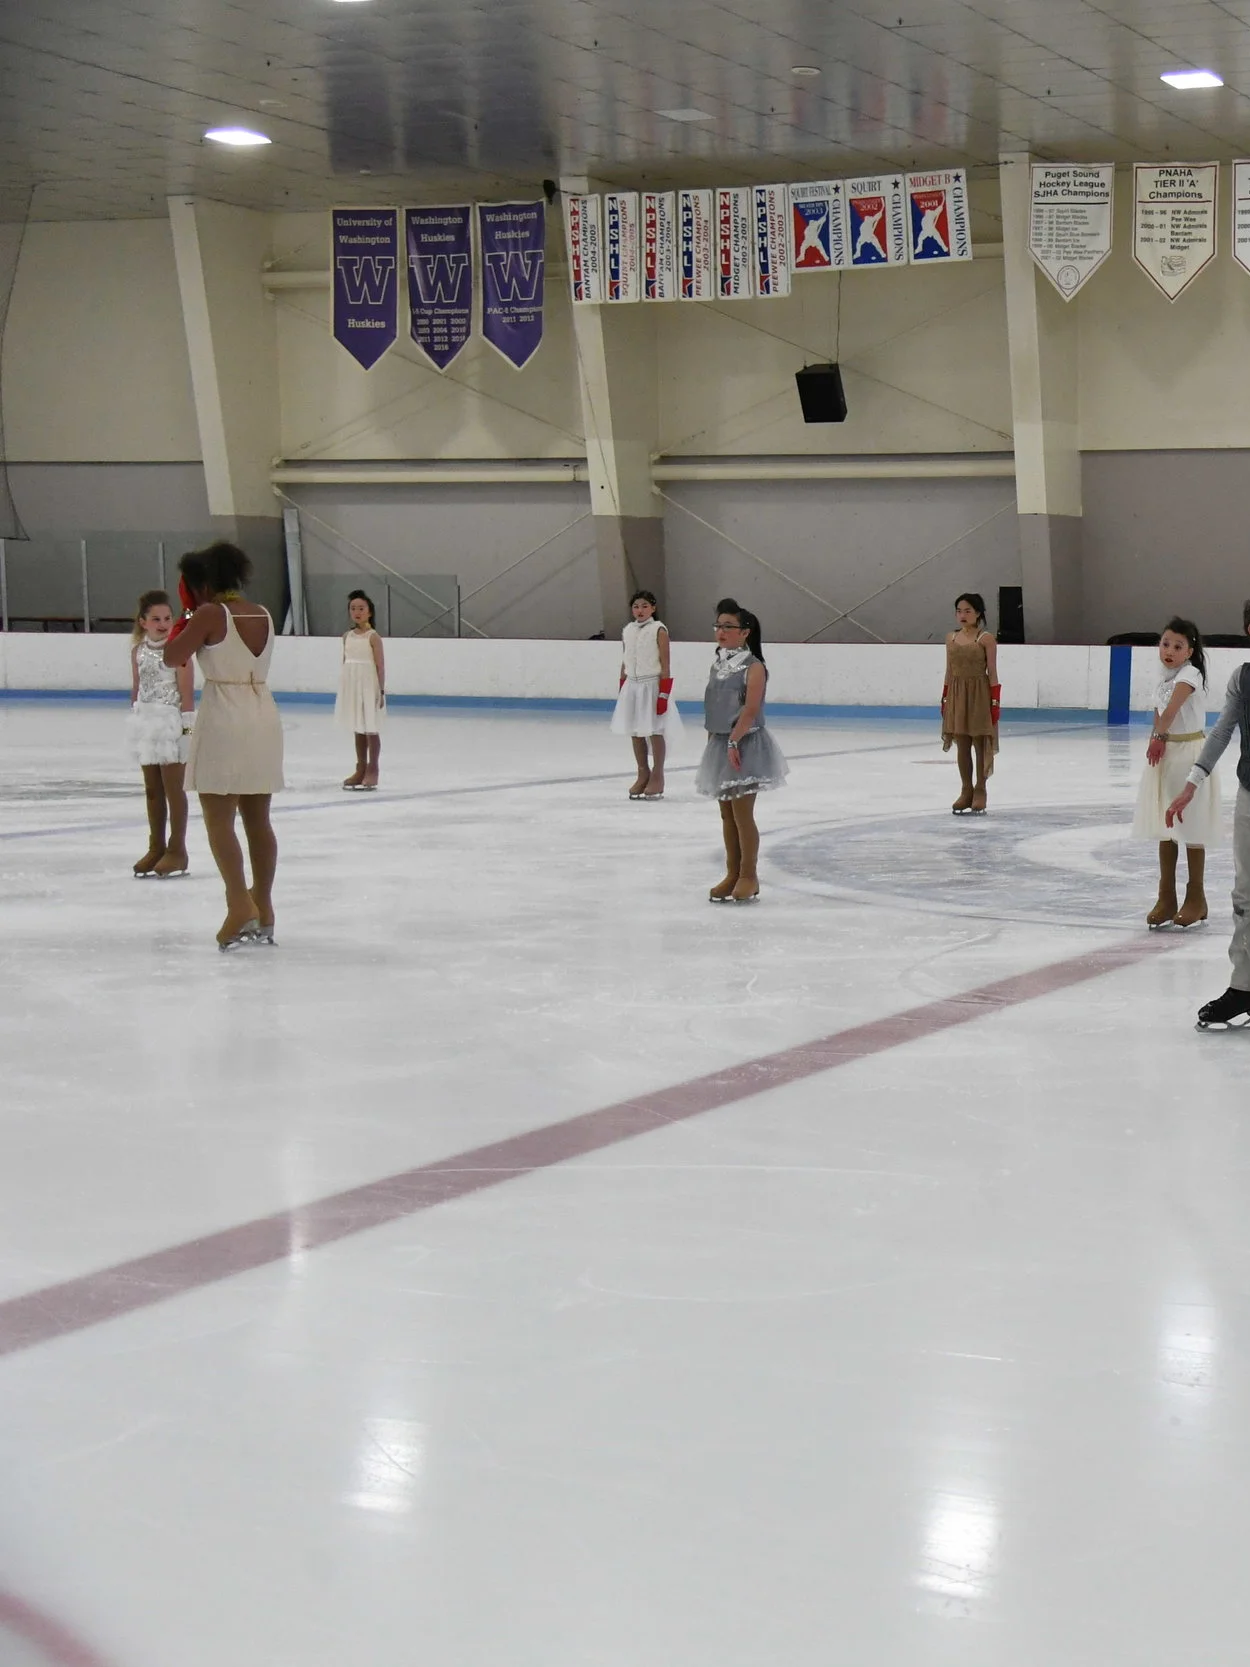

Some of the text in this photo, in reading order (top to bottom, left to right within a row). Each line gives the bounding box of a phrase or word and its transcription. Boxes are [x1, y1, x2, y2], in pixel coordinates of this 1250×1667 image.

[1045, 170, 1099, 179] Puget Sound
[1159, 169, 1193, 177] PNAHA
[851, 180, 882, 195] SQUIRT
[909, 174, 950, 188] MIDGET B
[1039, 180, 1106, 190] Hockey League
[1154, 180, 1176, 188] TIER
[1034, 189, 1110, 198] SJHA Champions
[1149, 191, 1203, 200] Champions
[337, 217, 393, 228] University of
[411, 216, 463, 225] Washington
[485, 211, 537, 222] Washington
[953, 187, 968, 257] CHAMPIONS
[683, 196, 692, 266] NPSHL
[692, 195, 701, 254] CHAMPIONS
[721, 194, 730, 264] NPSHL
[756, 192, 767, 263] NPSHL
[892, 194, 904, 261] CHAMPIONS
[420, 233, 455, 242] Huskies
[494, 230, 530, 239] Huskies
[570, 200, 580, 270] NPSHL
[609, 200, 619, 269] NPSHL
[646, 200, 656, 268] NPSHL
[831, 199, 844, 266] CHAMPIONS
[339, 235, 391, 245] Washington
[768, 190, 778, 292] PEEWEE CHAMPIONS
[581, 200, 591, 298] BANTAM CHAMPIONS
[347, 318, 386, 328] Huskies
